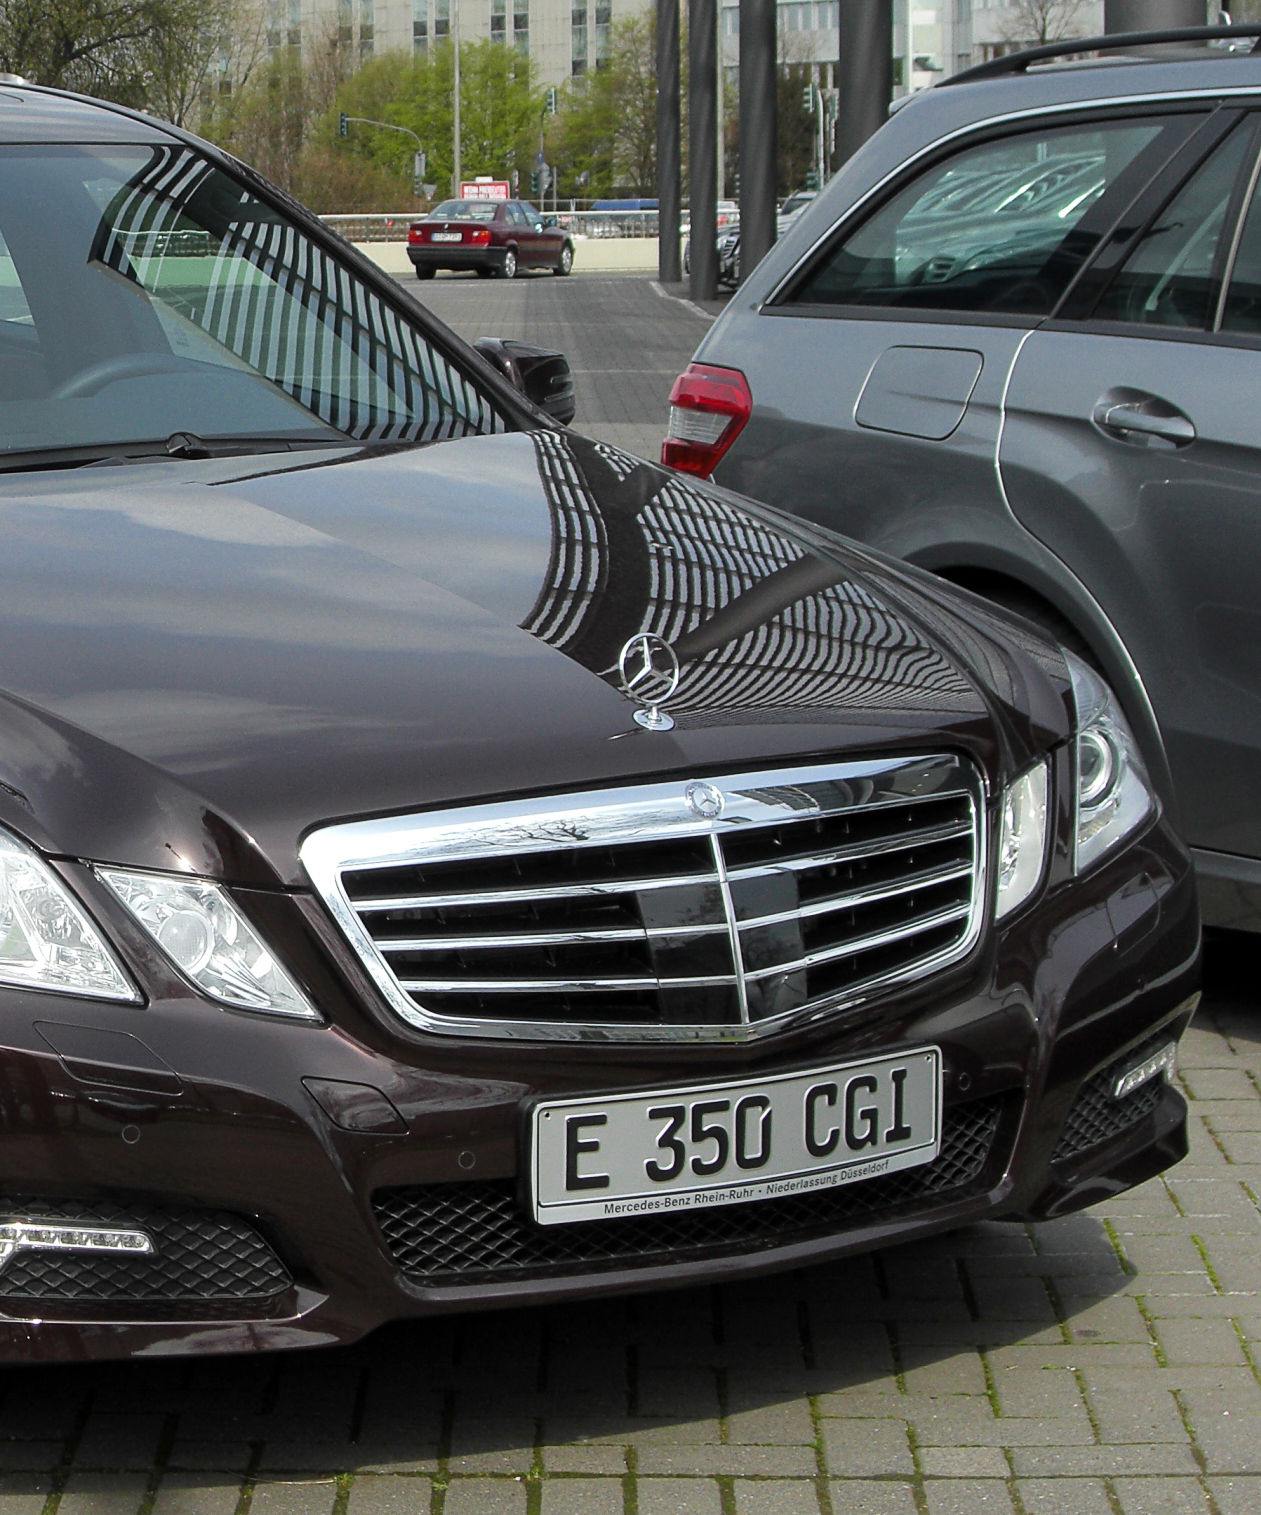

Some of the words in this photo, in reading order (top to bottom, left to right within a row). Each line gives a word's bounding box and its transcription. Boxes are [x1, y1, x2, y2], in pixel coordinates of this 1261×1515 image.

[565, 1112, 610, 1191] E
[643, 1093, 772, 1182] 350
[804, 1066, 912, 1158] CGI
[604, 1197, 691, 1214] Mercedes-Benz
[694, 1188, 755, 1204] Rhein-Ruhr
[766, 1174, 838, 1195] Niederlassung
[840, 1160, 890, 1181] Düsseldorf
